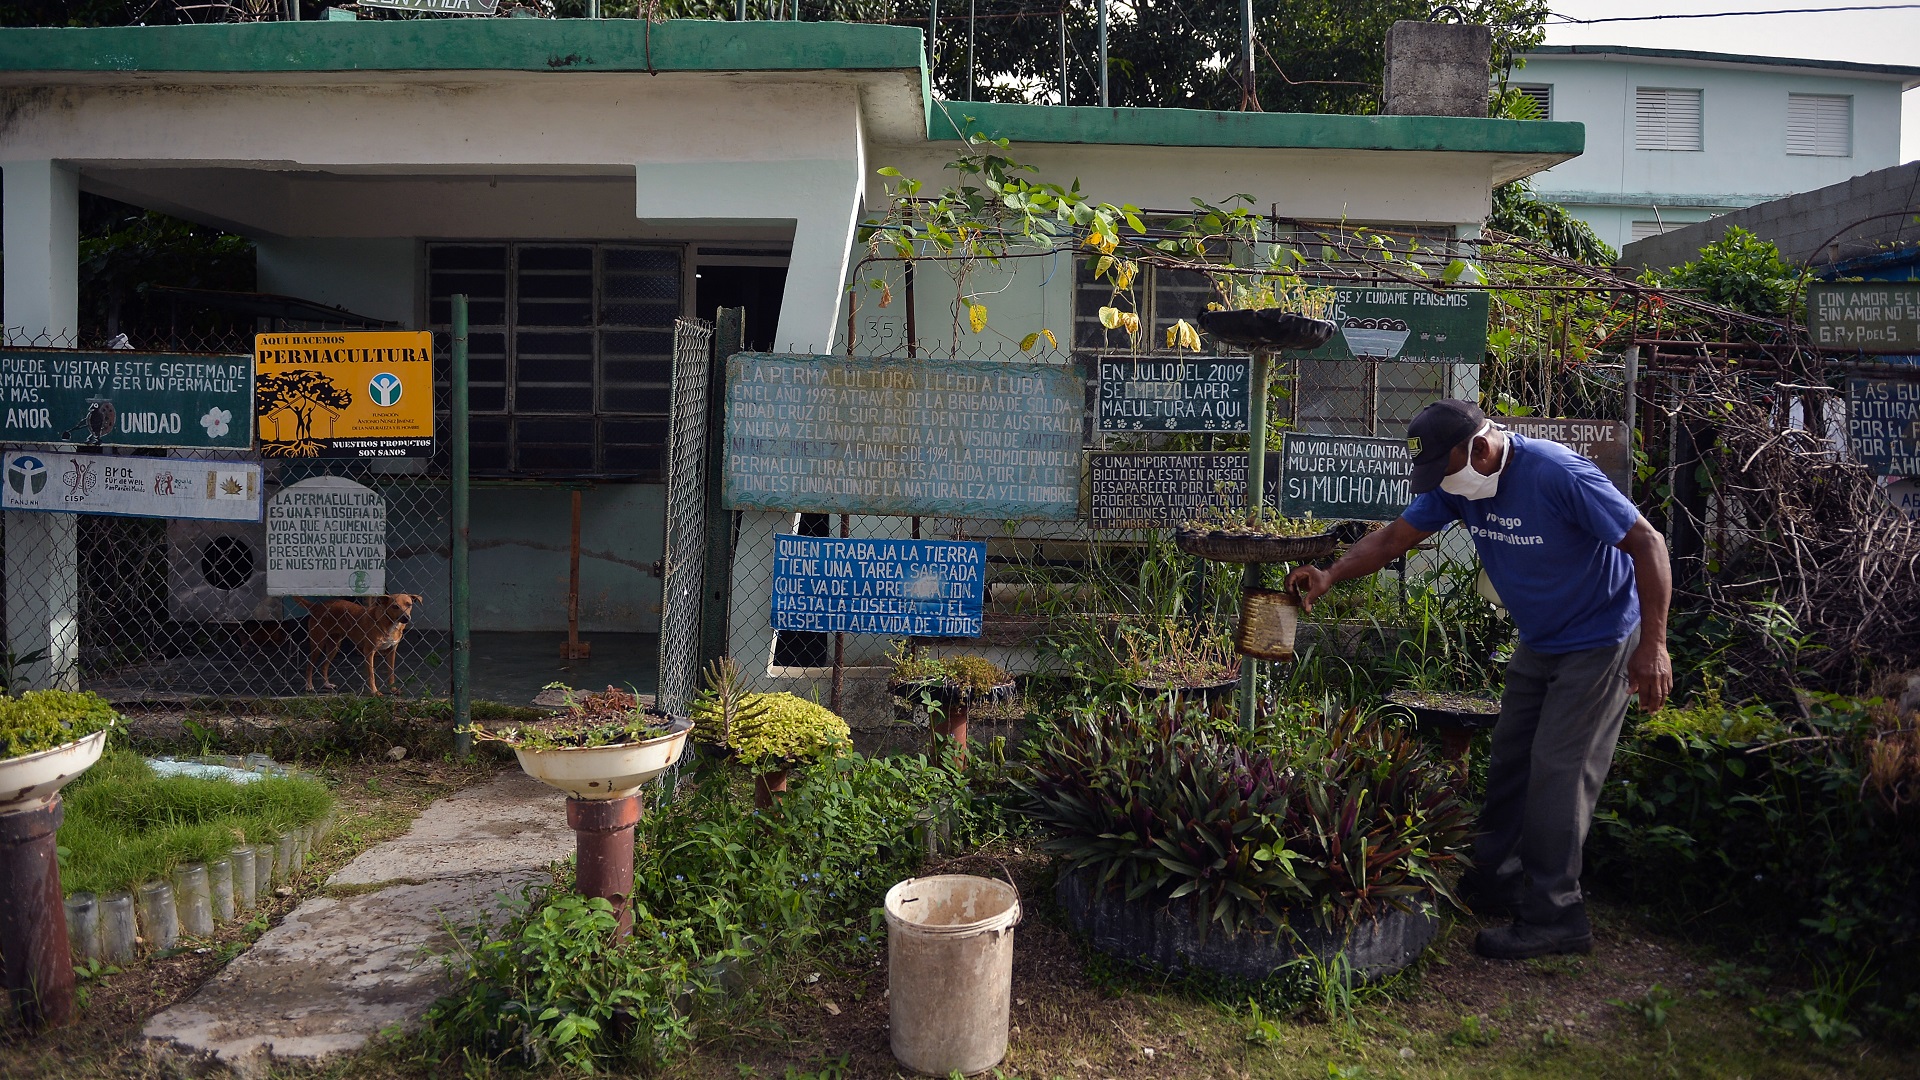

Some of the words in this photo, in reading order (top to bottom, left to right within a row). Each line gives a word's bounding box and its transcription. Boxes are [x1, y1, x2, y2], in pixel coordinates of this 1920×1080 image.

[1365, 291, 1408, 305] CUIDAME
[1413, 292, 1468, 308] PENSEMOS
[1818, 292, 1845, 307] CON
[1849, 292, 1888, 306] AMOR
[1894, 292, 1911, 306] SE
[1819, 307, 1841, 322] SIN
[1844, 307, 1881, 321] AMOR
[1884, 306, 1902, 320] NO
[261, 335, 289, 345] AQUÍ
[292, 336, 345, 345] HACEMOS
[259, 348, 430, 364] PERMACULTURA
[2, 359, 46, 373] PUEDE
[53, 361, 110, 375] VISITAR
[115, 361, 152, 376] ESTE
[160, 363, 226, 379] SISTEMA
[229, 365, 246, 379] DE
[1102, 363, 1124, 381] EN
[1130, 363, 1175, 382] JULIO
[1176, 364, 1204, 381] DEL
[1207, 364, 1245, 382] 2009
[98, 376, 106, 389] Y
[112, 376, 142, 390] SER
[146, 378, 165, 391] UN
[168, 378, 243, 393] PERMACUL-
[741, 365, 765, 383] LA
[770, 366, 916, 390] PERMACULTURA
[925, 373, 977, 393] LLEGO
[981, 376, 993, 393] A
[997, 376, 1046, 396] CUBA
[11, 388, 45, 403] MAS.
[734, 385, 751, 400] EN
[755, 387, 771, 402] EL
[775, 384, 802, 402] AÑO
[806, 388, 836, 404] 1993
[907, 392, 922, 408] DE
[925, 393, 945, 409] LA
[949, 394, 1005, 411] BRIGADA
[1007, 396, 1023, 412] DE
[1027, 397, 1080, 415] SOLIDA-
[1103, 382, 1123, 399] SE
[1124, 382, 1182, 400] EMPEZO
[1851, 382, 1889, 400] LAS
[5, 408, 52, 428] AMOR
[734, 402, 774, 418] RIDAD
[778, 404, 814, 421] CRUZ
[818, 406, 843, 422] DEL
[884, 407, 979, 428] PROCEDENTE
[983, 413, 1000, 429] DE
[1003, 414, 1083, 433] AUSTRALIA
[1102, 400, 1196, 418] MACULTURA
[1852, 401, 1920, 419] FUTURA
[121, 412, 181, 434] UNIDAD
[1849, 420, 1884, 438] POR
[1887, 421, 1907, 438] EL
[746, 421, 791, 438] NUEVA
[939, 429, 957, 445] LA
[960, 430, 998, 447] VISION
[1004, 432, 1020, 448] DE
[1571, 425, 1615, 441] SIRVE
[332, 441, 378, 449] NUESTROS
[380, 439, 431, 447] PRODUCTOS
[1290, 441, 1305, 454] NO
[1308, 442, 1364, 458] VIOLENCIA
[1365, 443, 1408, 459] CONTRA
[1851, 438, 1886, 456] POR
[1891, 440, 1909, 457] EL
[856, 443, 909, 461] FINALES
[955, 447, 972, 463] LA
[975, 449, 1045, 466] PROMOCION
[1047, 451, 1061, 466] DE
[1064, 452, 1079, 466] LA
[1134, 456, 1206, 468] IMPORTANTE
[731, 455, 846, 476] PERMACULTURA
[849, 461, 867, 477] EN
[870, 462, 907, 479] CUBA
[910, 463, 926, 480] ES
[928, 464, 983, 482] ACOGIDA
[987, 466, 1015, 483] POR
[1019, 467, 1039, 484] LA
[1288, 456, 1336, 472] MUJER
[1340, 459, 1348, 473] Y
[1350, 459, 1366, 474] LA
[1093, 469, 1156, 481] BIOLOGICA
[1159, 469, 1187, 481] ESTA
[1190, 469, 1204, 481] EN
[1207, 469, 1245, 481] RIESGO
[732, 473, 789, 492] TONCES
[792, 476, 862, 496] FUNDACION
[865, 479, 881, 496] DE
[884, 480, 905, 497] LA
[905, 482, 995, 500] NATURALEZA
[1010, 485, 1025, 501] EL
[1093, 481, 1177, 494] DESAPARECER
[1181, 481, 1203, 494] POR
[1288, 477, 1307, 500] SI
[1312, 476, 1373, 504] MUCHO
[275, 493, 292, 505] LA
[294, 493, 384, 506] PERMACULTURA
[1092, 494, 1166, 506] PROGRESIVA
[270, 507, 284, 518] ES
[287, 507, 313, 518] UNA
[314, 507, 370, 519] FILOSOFIA
[1092, 507, 1167, 519] CONDICIONES
[270, 520, 297, 532] VIDA
[300, 520, 320, 532] QUE
[324, 521, 367, 532] ASUMEN
[369, 521, 386, 532] LAS
[1498, 516, 1522, 529] ago
[268, 533, 327, 545] PERSONAS
[330, 533, 348, 546] QUE
[350, 533, 386, 545] DESEAN
[269, 546, 337, 558] PRESERVAR
[340, 547, 354, 558] LA
[779, 540, 820, 558] QUIEN
[823, 543, 897, 561] TRABAJA
[901, 544, 919, 561] LA
[924, 546, 979, 564] TIERRA
[270, 559, 283, 570] DE
[286, 559, 337, 570] NUESTRO
[340, 559, 386, 570] PLANETA
[779, 558, 820, 577] TIENE
[824, 560, 853, 578] UNA
[858, 561, 904, 579] TAREA
[910, 563, 978, 582] SAGRADA
[810, 579, 828, 596] VA
[831, 580, 849, 597] DE
[853, 581, 872, 597] LA
[777, 596, 824, 612] HASTA
[828, 598, 847, 613] LA
[851, 598, 917, 614] COSECHA
[948, 600, 967, 616] EL
[777, 613, 845, 630] RESPETO
[880, 616, 912, 633] VIDA
[915, 617, 932, 633] DE
[937, 617, 981, 634] TODOS
